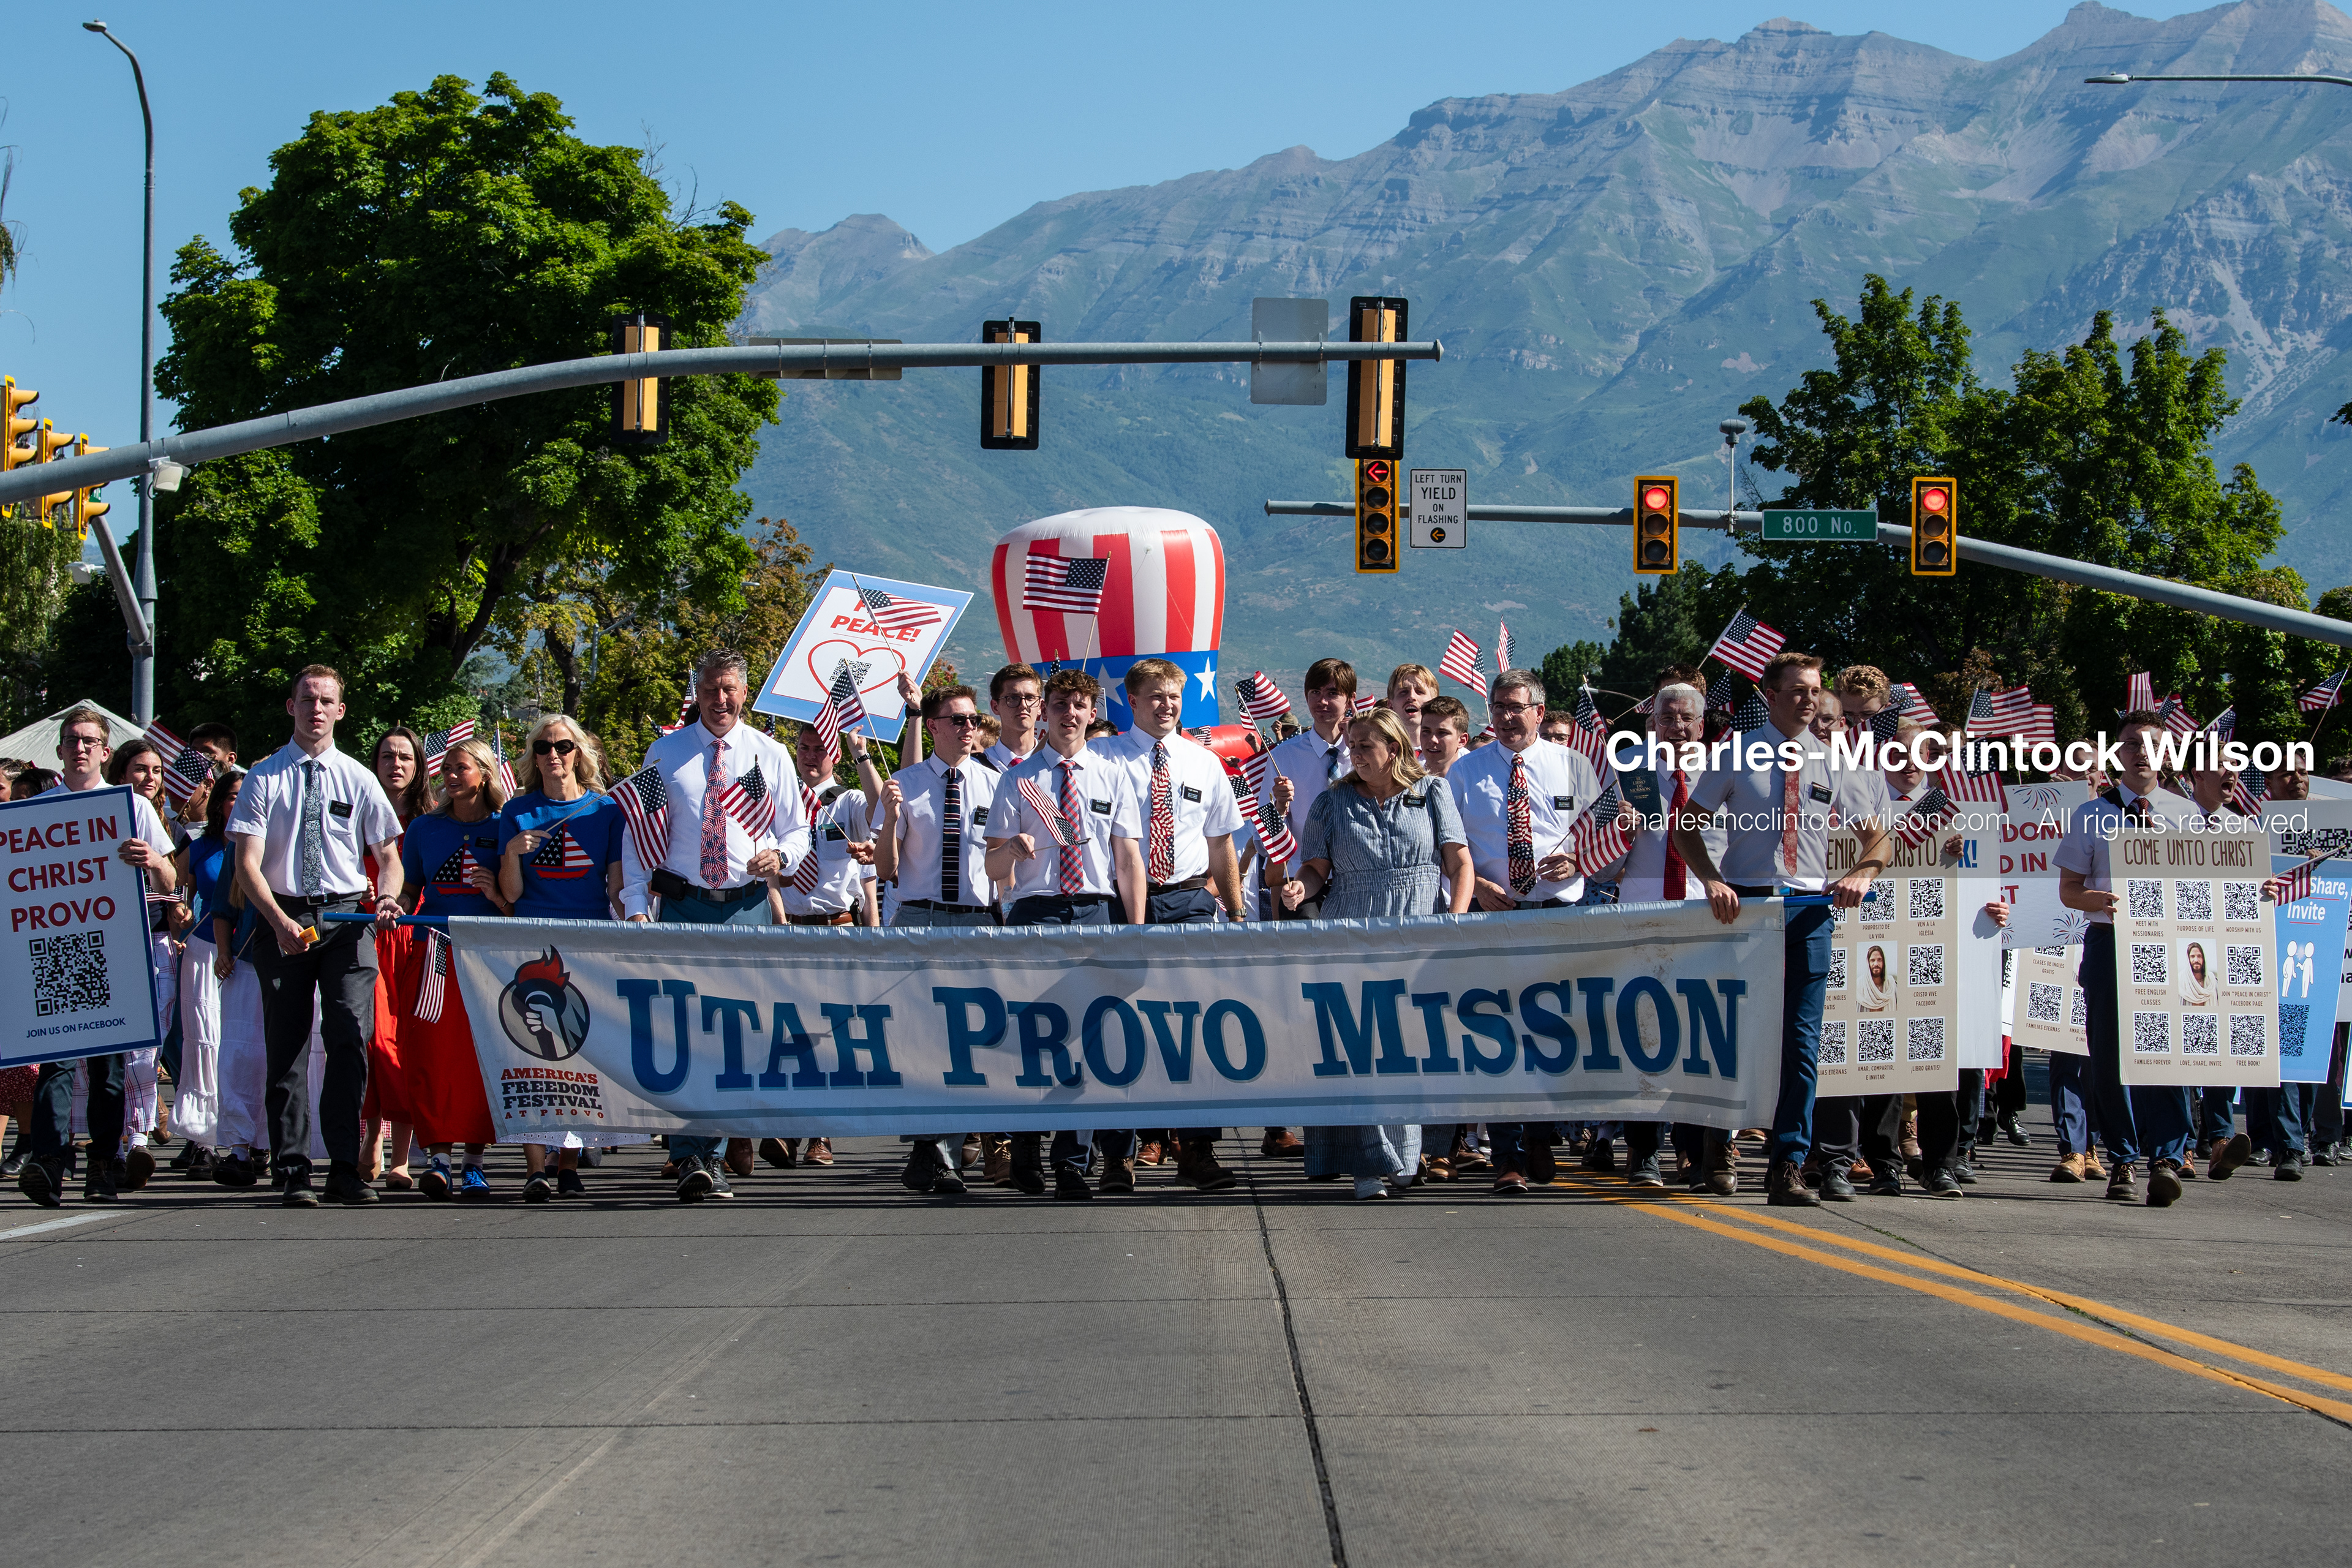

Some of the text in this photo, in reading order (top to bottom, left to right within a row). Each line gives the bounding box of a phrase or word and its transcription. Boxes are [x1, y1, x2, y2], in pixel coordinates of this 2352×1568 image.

[1415, 474, 1461, 483] LEFT TURN
[1421, 487, 1456, 500] YIELD
[1433, 503, 1444, 512] ON
[1418, 515, 1458, 524] FLASHING
[1783, 516, 1818, 533] 800
[830, 615, 922, 643] PEACE!
[88, 815, 118, 843] IN
[1886, 835, 1937, 868] RISTO
[2124, 839, 2254, 867] COME UNTO CHRIST
[2021, 852, 2048, 872] IN
[8, 856, 109, 892] CHRIST
[2309, 876, 2348, 900] Share,
[10, 895, 116, 933] PROVO
[2287, 902, 2325, 921] Invite
[26, 1017, 126, 1038] JOIN US ON FACEBOOK
[616, 975, 1747, 1096] UTAH PROVO MISSION
[500, 1068, 598, 1084] AMERICA'S
[501, 1080, 600, 1098] FREEDOM
[503, 1095, 603, 1110] FESTIVAL
[505, 1109, 604, 1119] AT PROVO
